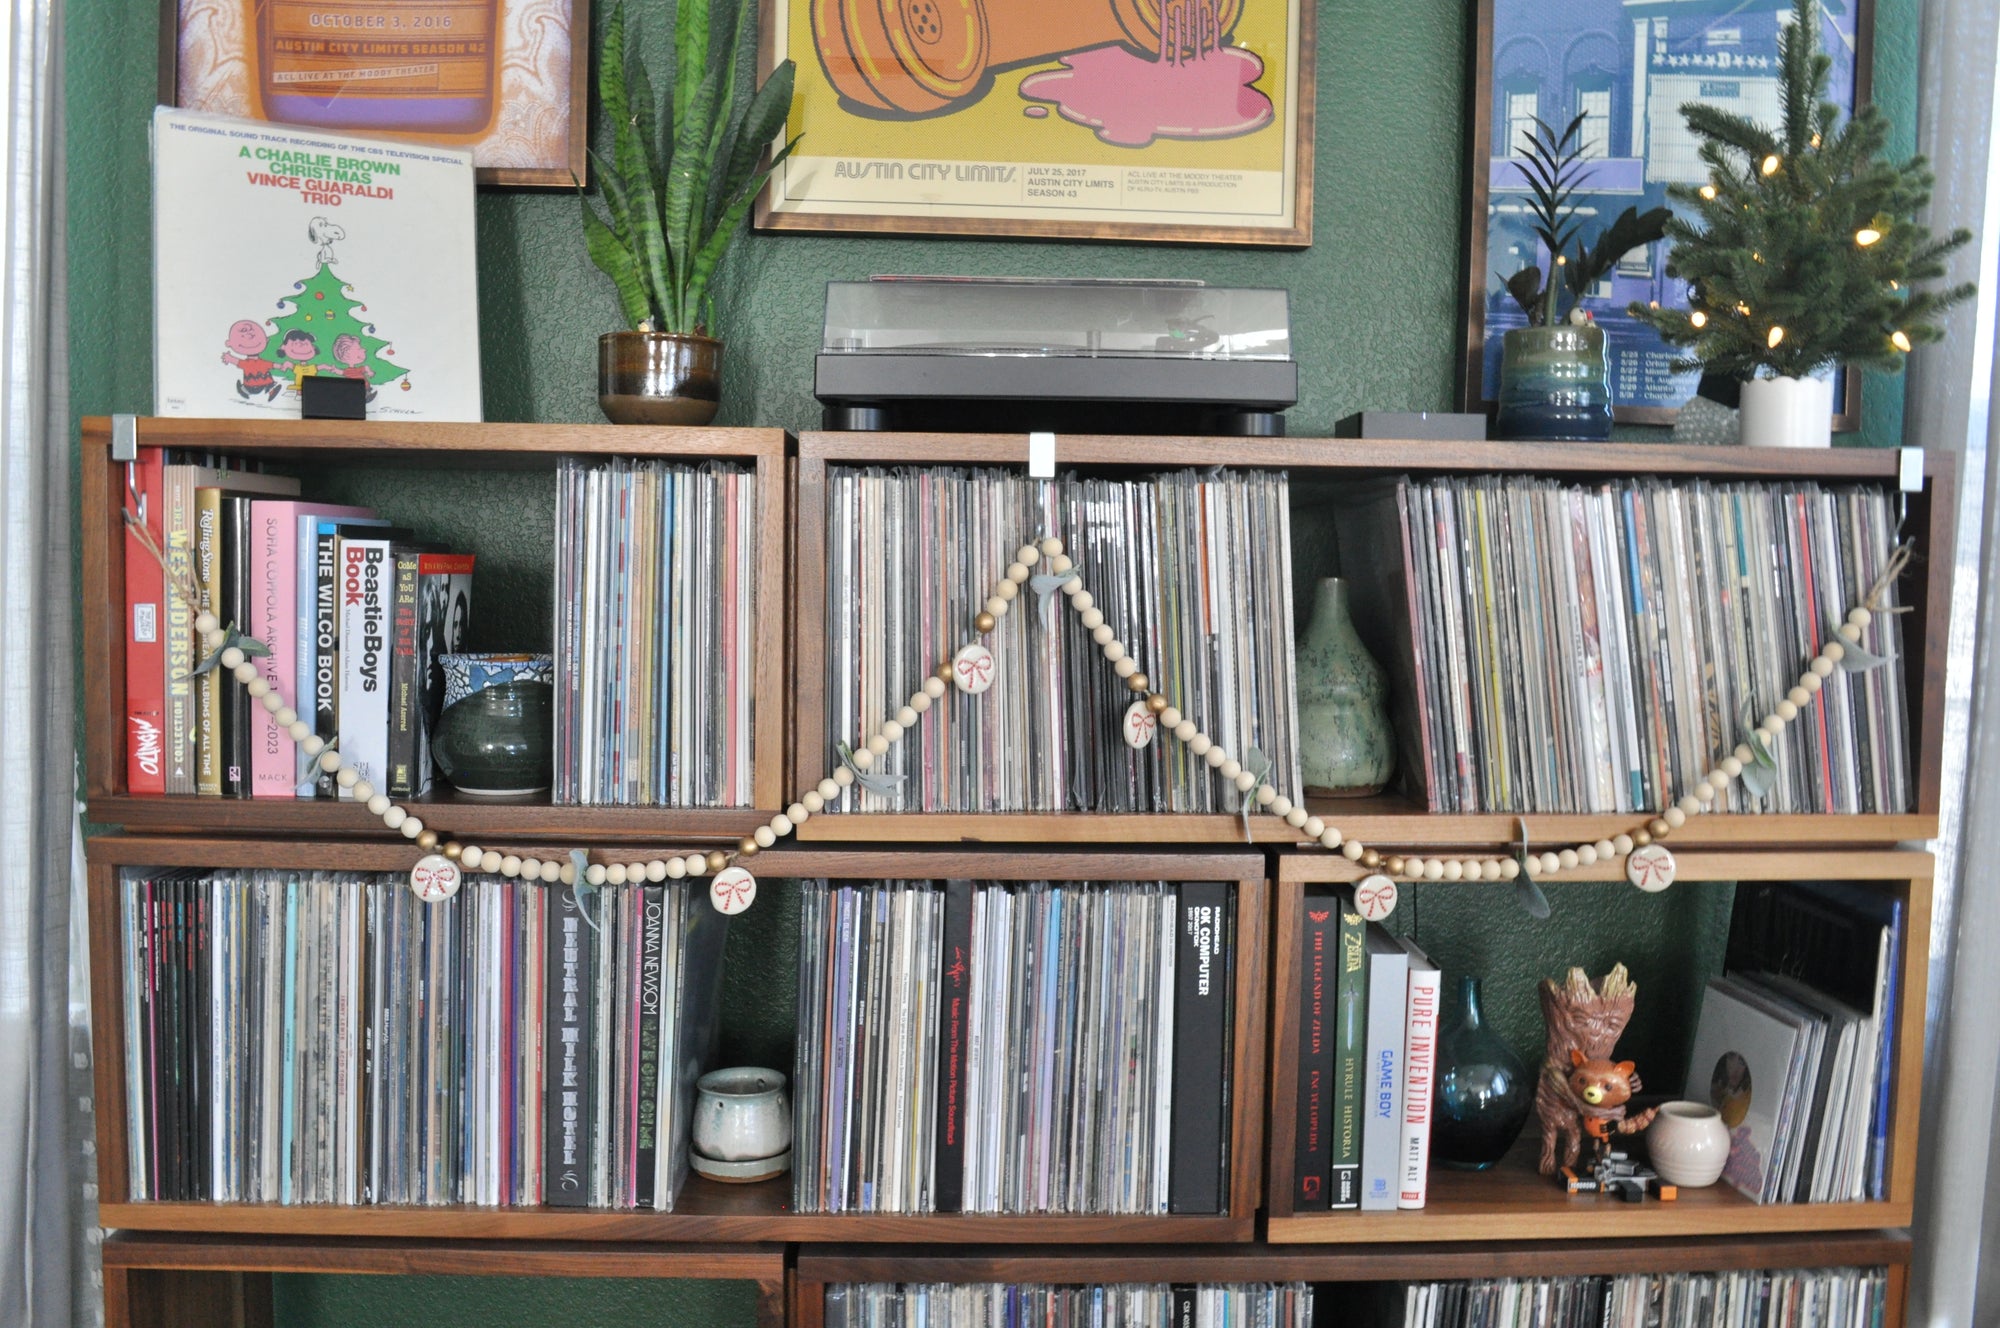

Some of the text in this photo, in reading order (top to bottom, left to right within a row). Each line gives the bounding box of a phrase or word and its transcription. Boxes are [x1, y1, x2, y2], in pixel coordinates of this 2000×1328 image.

[309, 13, 453, 29] OCTOBER 3. 2016
[276, 39, 487, 55] AUSTIN CITY LIMITS SEASON 42
[298, 73, 319, 81] LIVE
[337, 71, 354, 79] THE
[359, 68, 392, 78] MOODY
[395, 65, 436, 75] THEATER
[169, 122, 465, 166] THE ORIGINAL SOUND TRACK RECORDING OF THE CBS TELEVISION SPECIAL
[238, 145, 402, 176] A CHARLIE BROWN
[834, 160, 1017, 184] AUSTIN CITY LIMITS
[1028, 167, 1086, 178] JULY 25, 2017
[269, 161, 373, 185] CHRISTMAS
[1028, 178, 1115, 189] AUSTIN CITY LIMITS
[247, 171, 395, 201] VINCE GUARALDI
[1028, 188, 1077, 198] SEASON 43
[300, 190, 342, 207] TRIO
[168, 529, 190, 580] WES
[345, 546, 365, 607] Book
[202, 589, 211, 608] THE
[266, 517, 279, 682] SOFIA COPPOLA ARCHIVE
[317, 538, 334, 712] THE WILCO BOOK
[202, 680, 211, 718] ALBUMS
[400, 682, 409, 706] Michael
[174, 701, 185, 763] COLLECTION
[203, 719, 212, 733] OF
[129, 716, 161, 777] MONDO
[202, 734, 212, 752] ALL
[202, 752, 212, 776] TIME
[258, 773, 288, 782] MACK
[645, 899, 661, 953] JOANNA
[1213, 906, 1221, 955] RADIOHEAD
[1198, 906, 1211, 996] OK COMPUTER
[642, 956, 660, 1015] NEWSOM
[951, 997, 960, 1019] Music
[561, 917, 580, 1165] NEUTRAL MILK HOTEL
[951, 1020, 959, 1038] From
[950, 1040, 958, 1053] The
[1309, 931, 1323, 1152] THE LEGEND OF ZELDA ENCYCLOPEDIA
[1342, 932, 1362, 1159] ZELDA HYRULE HISTORIA
[949, 1054, 958, 1078] Motion
[948, 1079, 957, 1103] Picture
[1379, 1050, 1393, 1119] GAME BOY
[1405, 986, 1434, 1182] PURE INVENTION MATT ALT
[640, 1099, 656, 1124] ON
[947, 1105, 956, 1145] Soundtrack
[639, 1126, 654, 1149] ME
